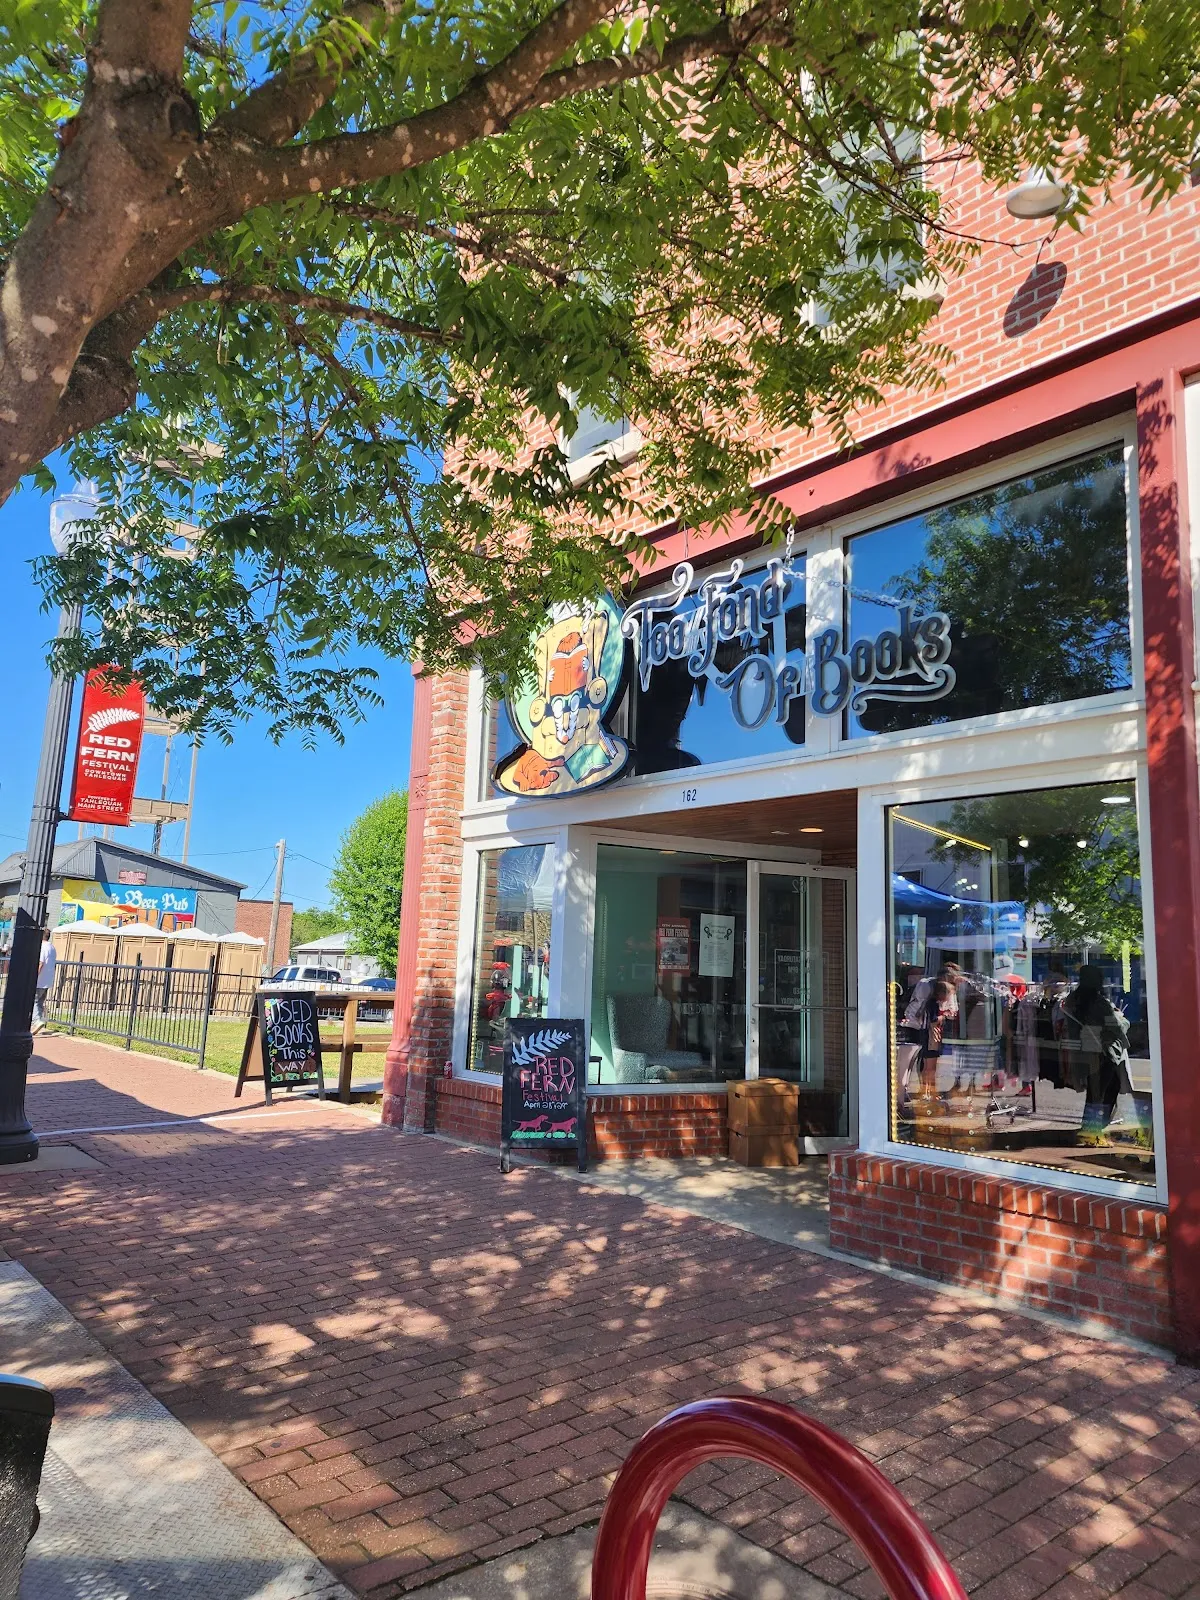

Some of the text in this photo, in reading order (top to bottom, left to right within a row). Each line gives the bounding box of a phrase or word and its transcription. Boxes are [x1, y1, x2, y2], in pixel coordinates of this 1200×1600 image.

[620, 557, 786, 692] Too Fond
[716, 604, 955, 731] Of Books
[89, 733, 131, 748] RED
[80, 746, 136, 763] FERN
[82, 759, 131, 772] FESTIVAL
[84, 768, 127, 778] DOWNTOWN
[84, 772, 127, 782] TAHLEQUAH
[80, 797, 122, 807] TAHLEQUAH
[682, 788, 697, 802] 162
[77, 802, 124, 812] MAIN STREET
[124, 890, 159, 909] Beer
[161, 893, 189, 911] Pub
[270, 999, 312, 1025] USED
[271, 1022, 314, 1048] BOOKS
[278, 1046, 306, 1060] This
[277, 1060, 306, 1072] WAY
[534, 1056, 575, 1078] RED
[519, 1069, 576, 1095] FERN
[522, 1089, 563, 1102] Festival
[523, 1100, 541, 1110] April
